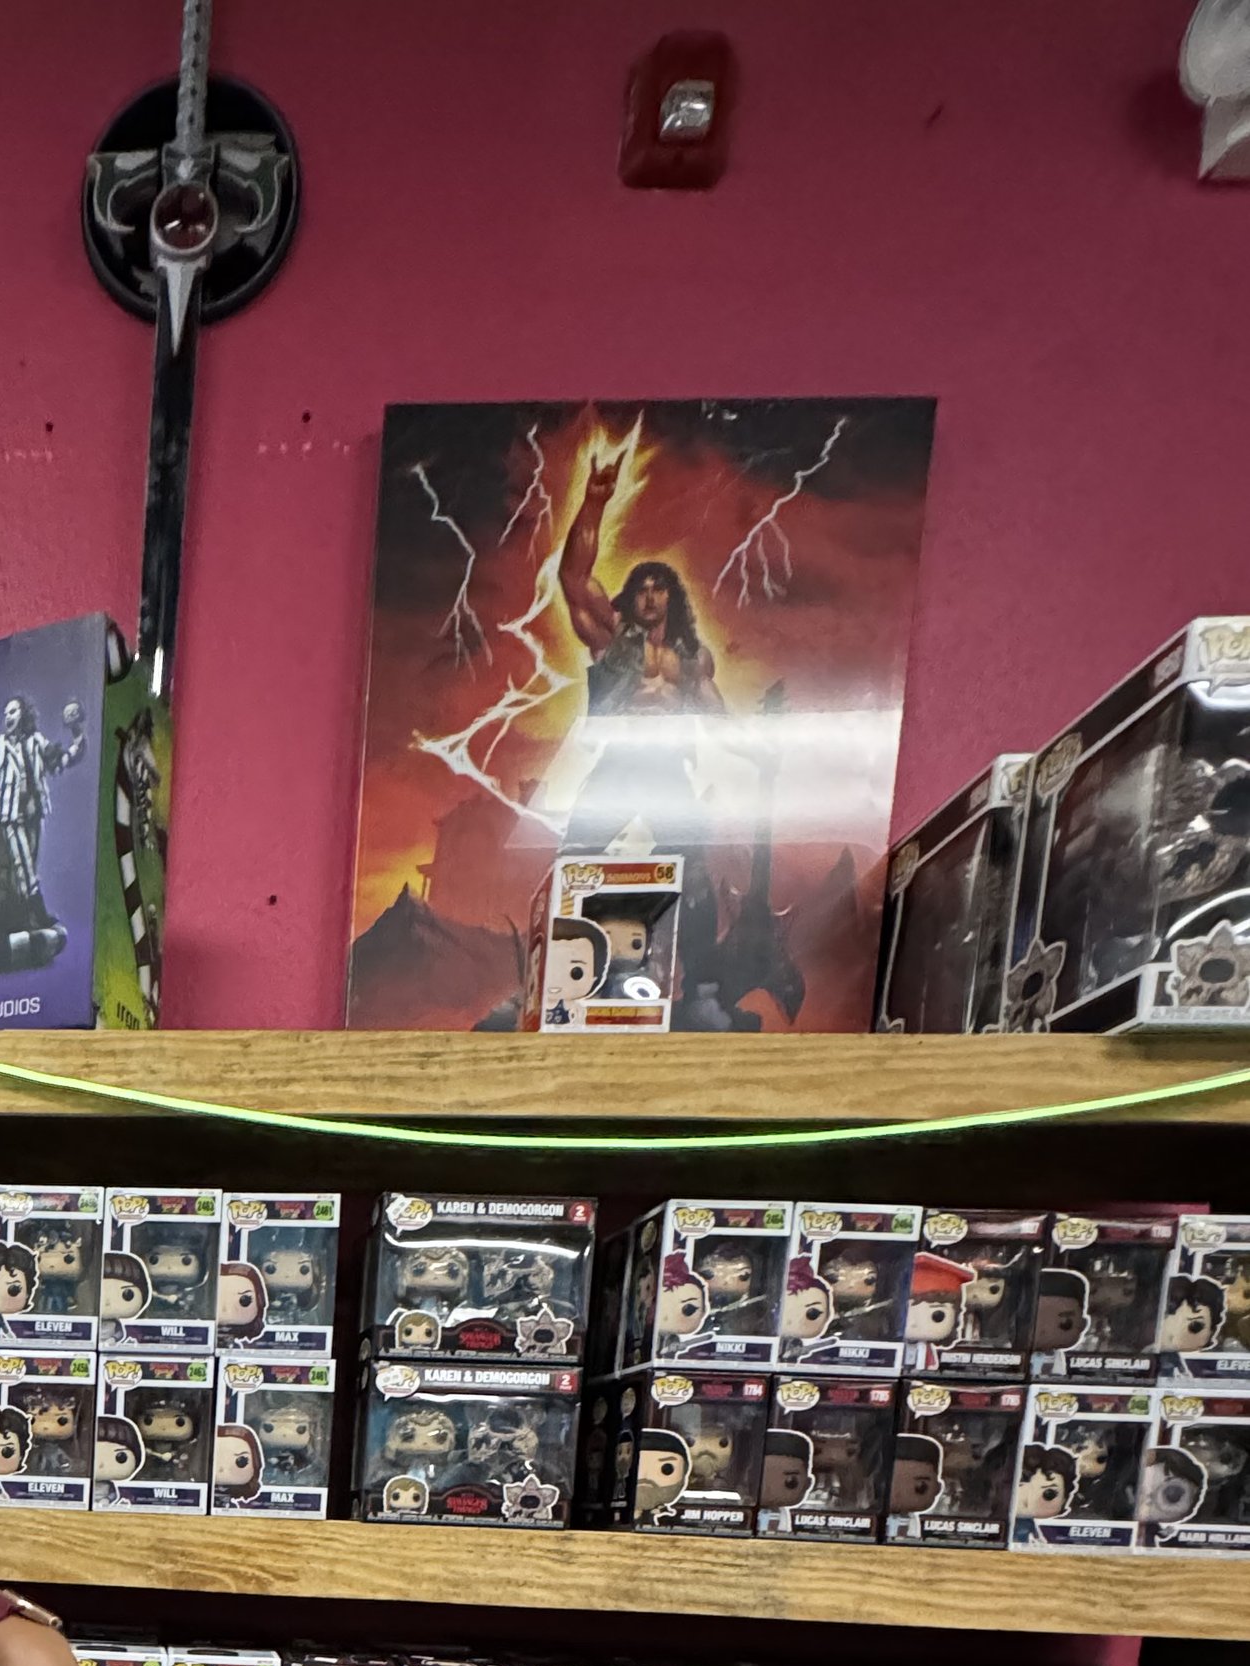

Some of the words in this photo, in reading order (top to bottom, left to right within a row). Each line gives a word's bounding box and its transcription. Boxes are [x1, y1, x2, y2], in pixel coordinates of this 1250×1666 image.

[657, 866, 675, 880] 58
[436, 1201, 474, 1214] KAREN
[476, 1202, 486, 1214] &
[488, 1202, 564, 1217] DEMOGORGON
[575, 1206, 585, 1216] 2
[34, 1321, 73, 1333] ELEVEN
[160, 1325, 186, 1337] WILL
[274, 1331, 300, 1342] MAX
[715, 1342, 747, 1354] NIKKI
[838, 1347, 870, 1359] NIKKI
[105, 1360, 142, 1379] POP!
[1069, 1356, 1102, 1370] LUCAS
[1104, 1357, 1150, 1371] SINCLAIR
[424, 1368, 463, 1382] KAREN
[464, 1370, 473, 1383] &
[474, 1371, 551, 1386] DEMOGORGON
[561, 1374, 571, 1386] 2
[27, 1481, 65, 1494] ELEVEN
[153, 1487, 178, 1499] WILL
[270, 1492, 295, 1503] MAX
[680, 1509, 701, 1521] JIM
[702, 1510, 744, 1523] HOPPER
[794, 1514, 825, 1527] LUCAS
[827, 1515, 871, 1529] SINCLAIR
[923, 1520, 955, 1532] LUCAS
[956, 1521, 1000, 1535] SINCLAIR
[1068, 1526, 1111, 1539] ELEVEN
